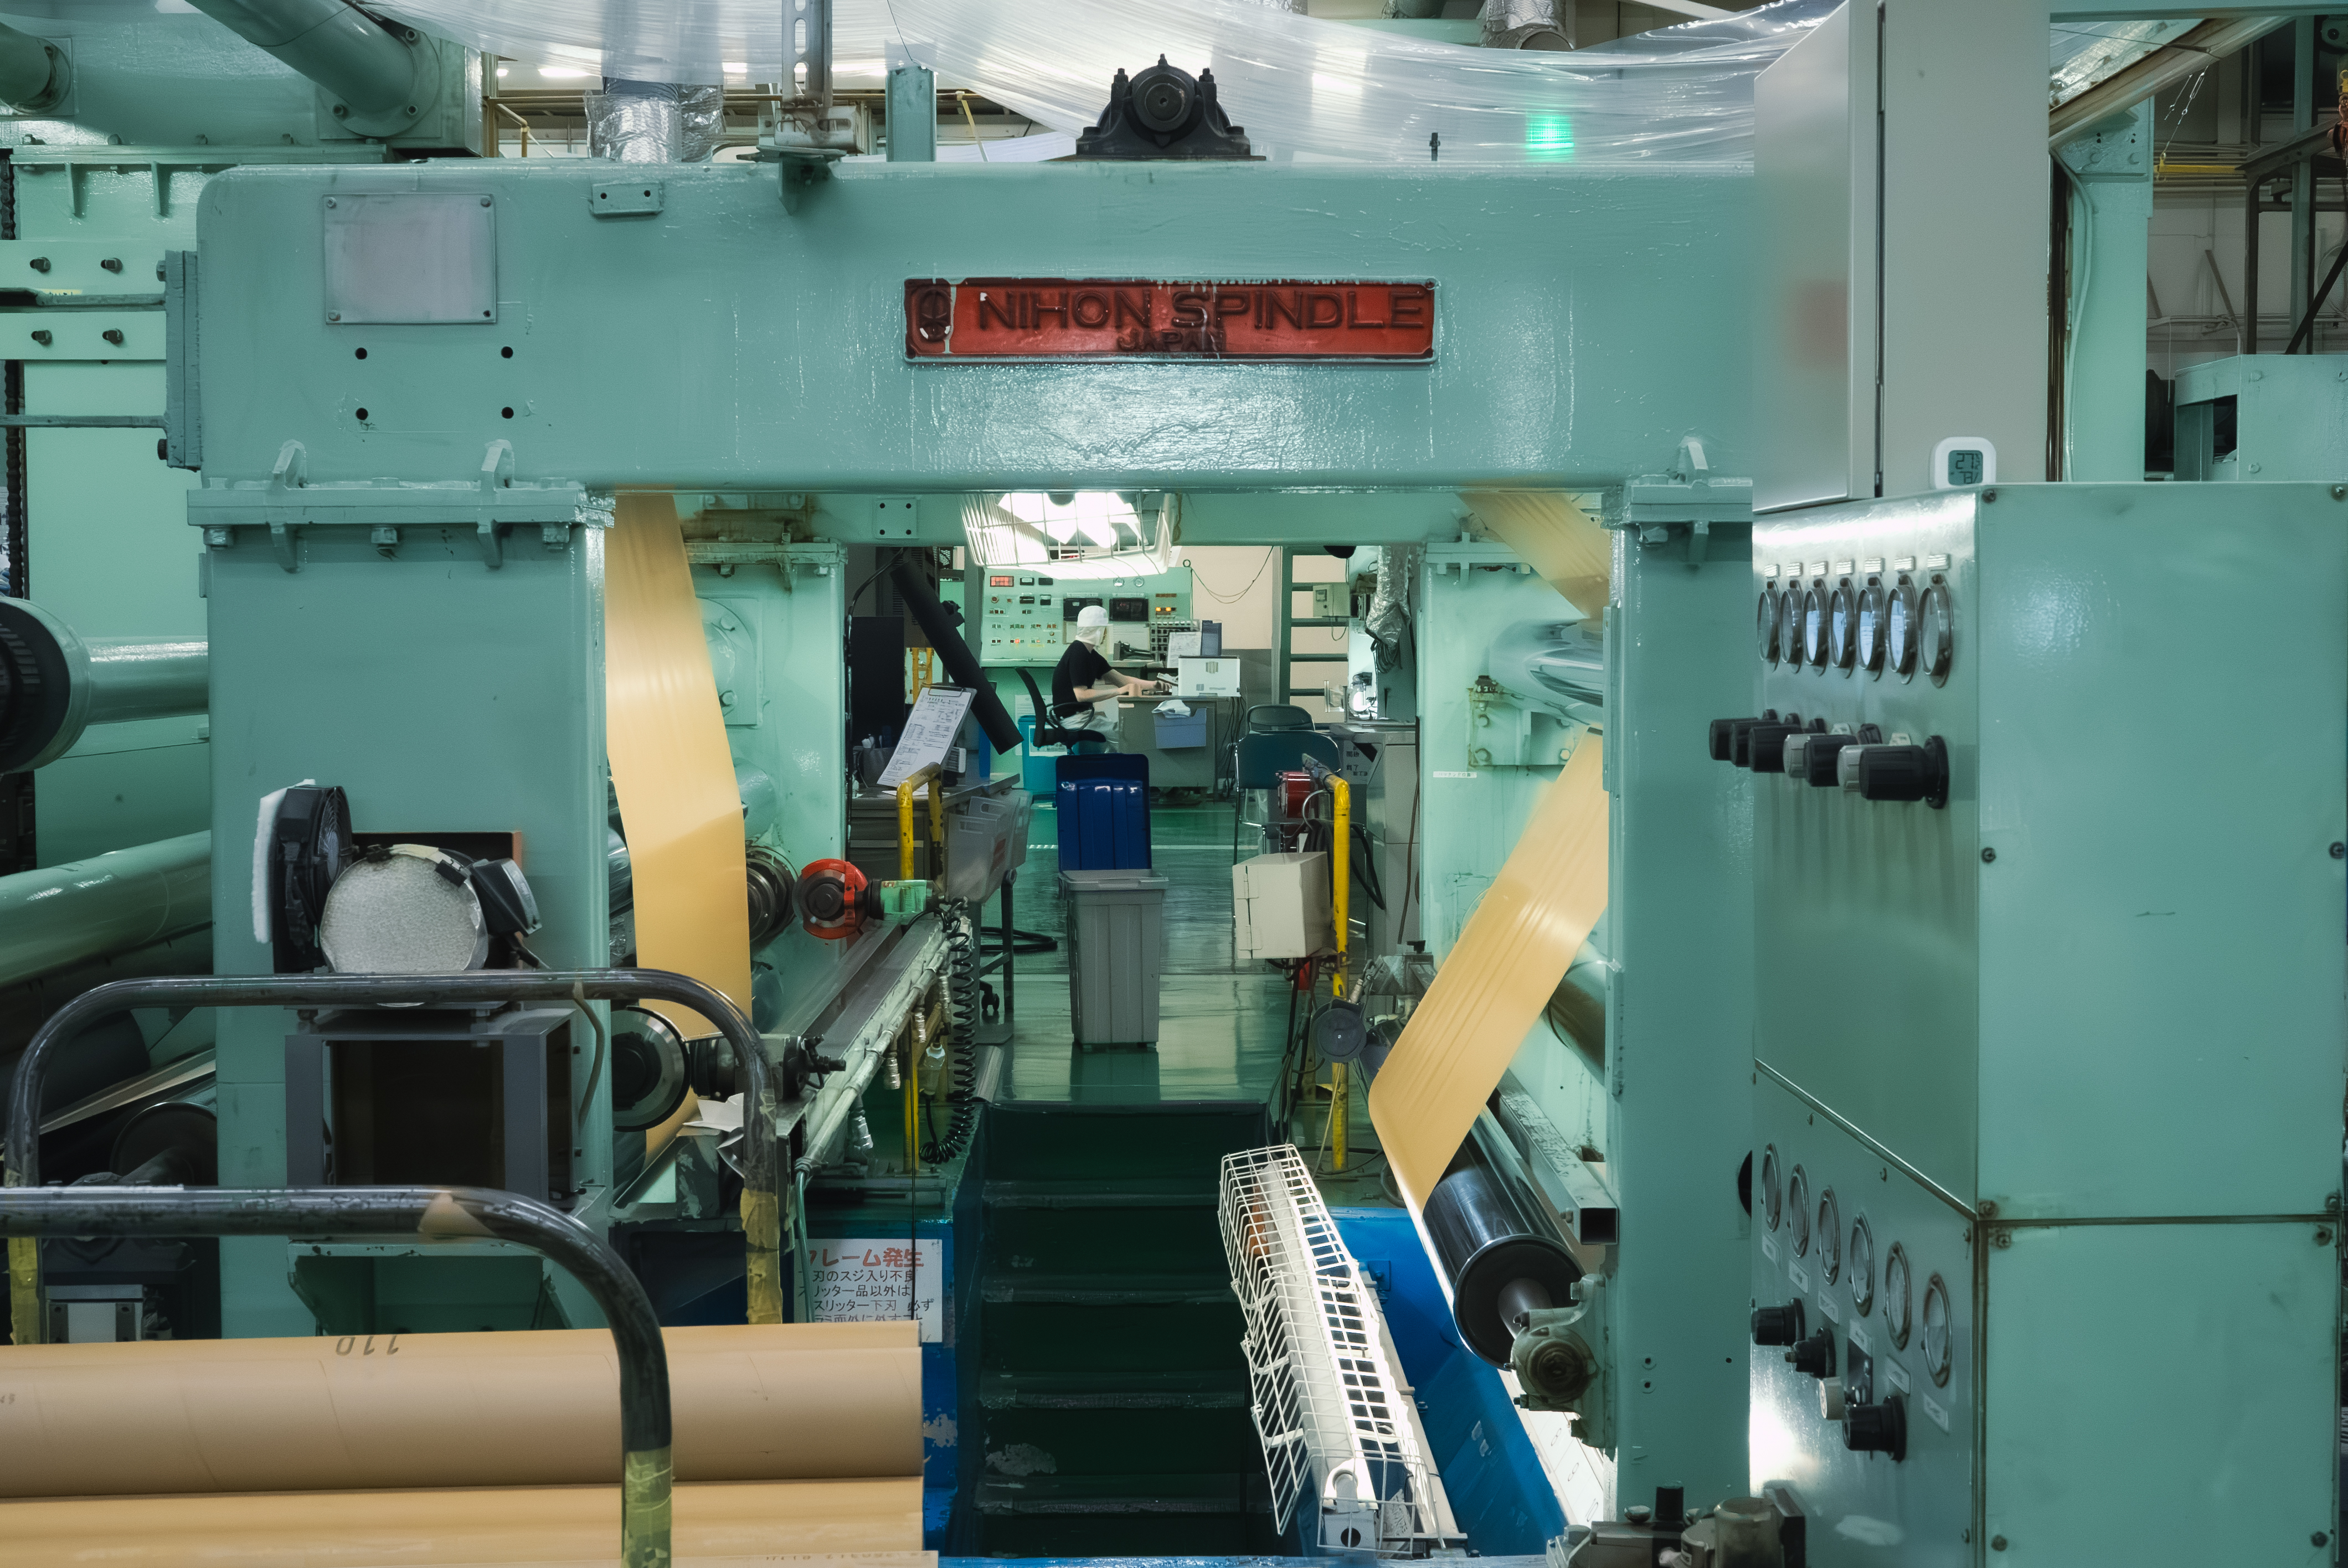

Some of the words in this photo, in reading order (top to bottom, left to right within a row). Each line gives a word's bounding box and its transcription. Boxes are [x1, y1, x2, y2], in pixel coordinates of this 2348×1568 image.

[979, 290, 1150, 329] NIHON
[1171, 290, 1425, 329] SPINDLE
[1116, 329, 1224, 352] JAPAN
[799, 1269, 914, 1282] 刃のスジ入り不良
[1584, 1498, 1599, 1523] 10
